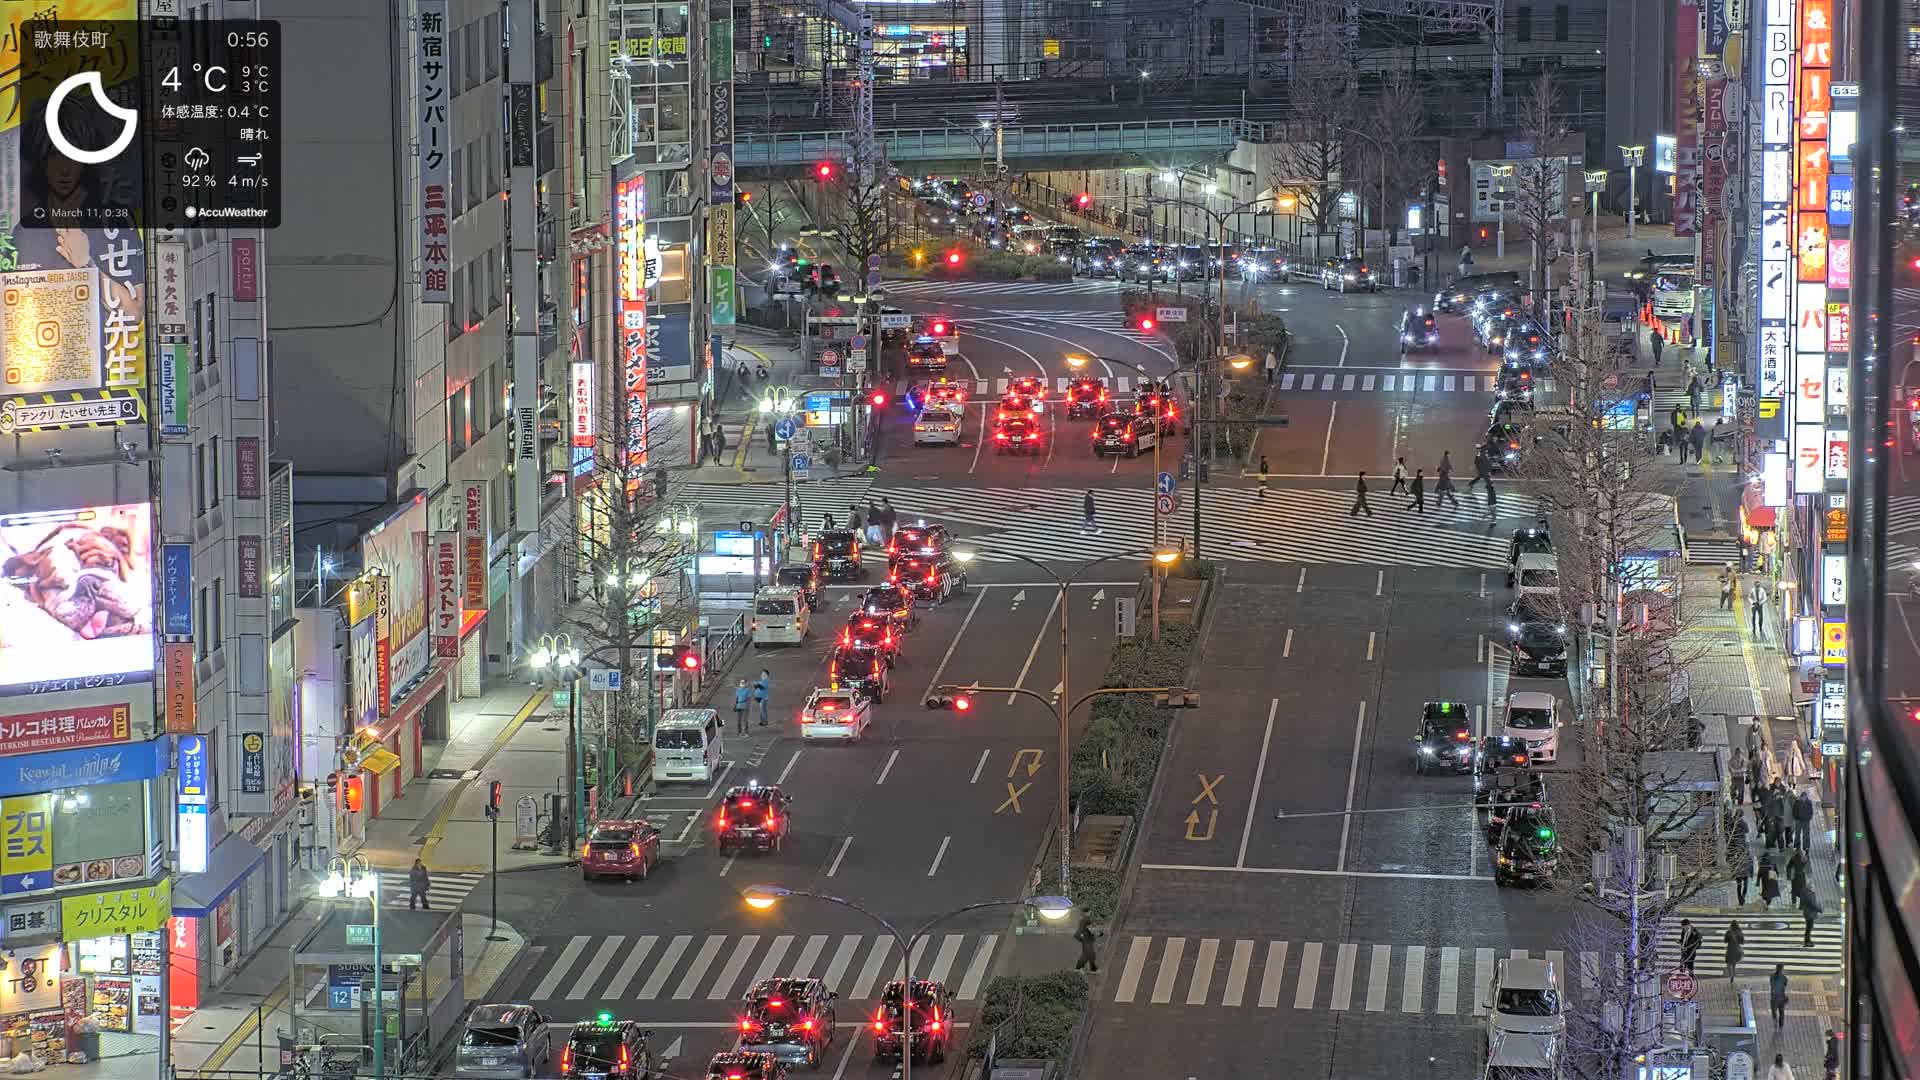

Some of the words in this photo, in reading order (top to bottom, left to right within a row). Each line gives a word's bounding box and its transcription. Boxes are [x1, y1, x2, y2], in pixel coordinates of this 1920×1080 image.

[1711, 0, 1723, 45] ントラル
[422, 13, 443, 169] 新宿サンパーク
[425, 185, 447, 291] 三平本館
[2, 273, 47, 288] Instagram
[716, 274, 728, 314] レイク
[626, 331, 643, 387] ラーメン
[1764, 330, 1777, 382] 大衆酒場
[163, 353, 174, 415] FamilyMart
[60, 405, 117, 418] たいせい先生
[519, 407, 533, 460] HOMEGAME
[467, 488, 478, 531] GAME
[1832, 498, 1843, 506] 3F
[438, 543, 455, 629] 三平ストア
[85, 674, 126, 688] ビジョン
[0, 715, 76, 739] トルコ料理
[31, 734, 76, 747] RESTAURANT
[6, 811, 46, 836] プロ
[7, 836, 46, 858] ミス
[10, 911, 46, 932] 囲碁
[75, 902, 148, 927] クリスタル
[332, 991, 348, 1004] 12
